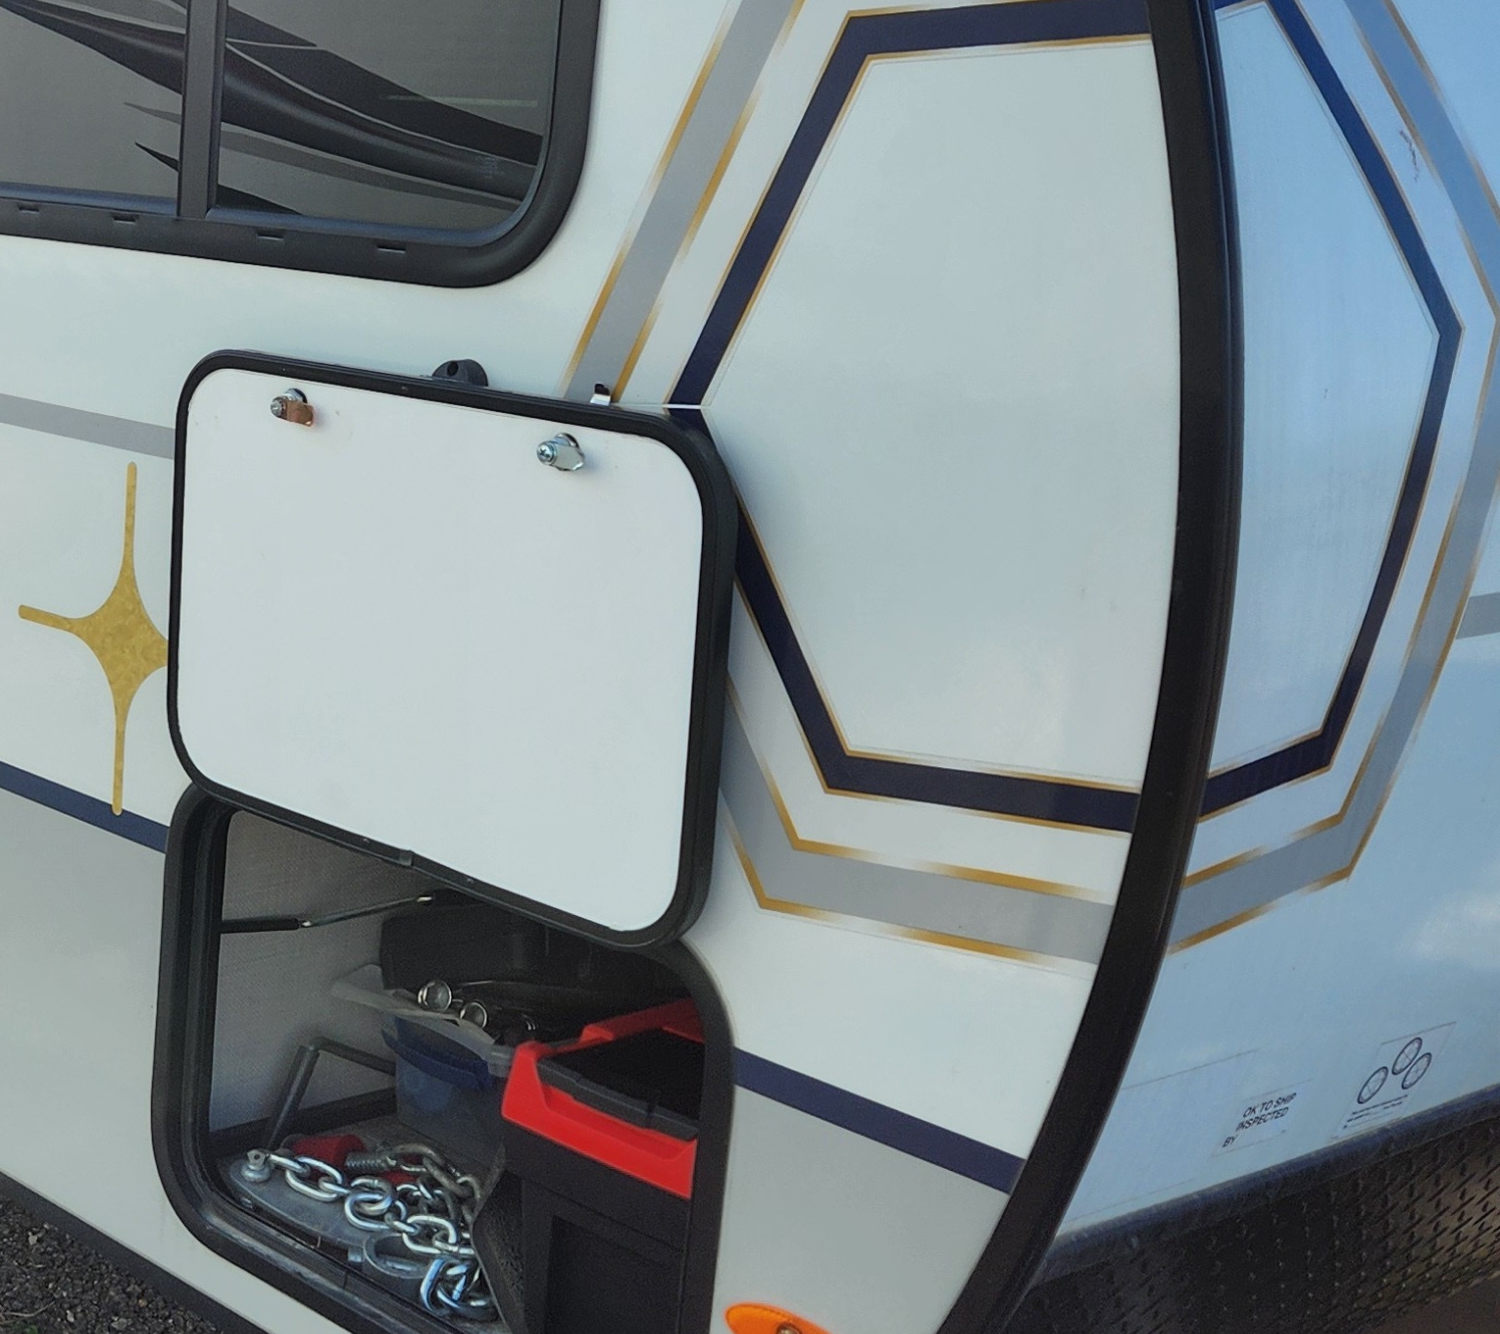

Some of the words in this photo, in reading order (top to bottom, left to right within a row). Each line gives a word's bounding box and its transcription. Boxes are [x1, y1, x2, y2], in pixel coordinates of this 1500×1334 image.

[1243, 1103, 1260, 1117] OK
[1260, 1099, 1275, 1111] TO
[1236, 1107, 1289, 1131] INSPECTED
